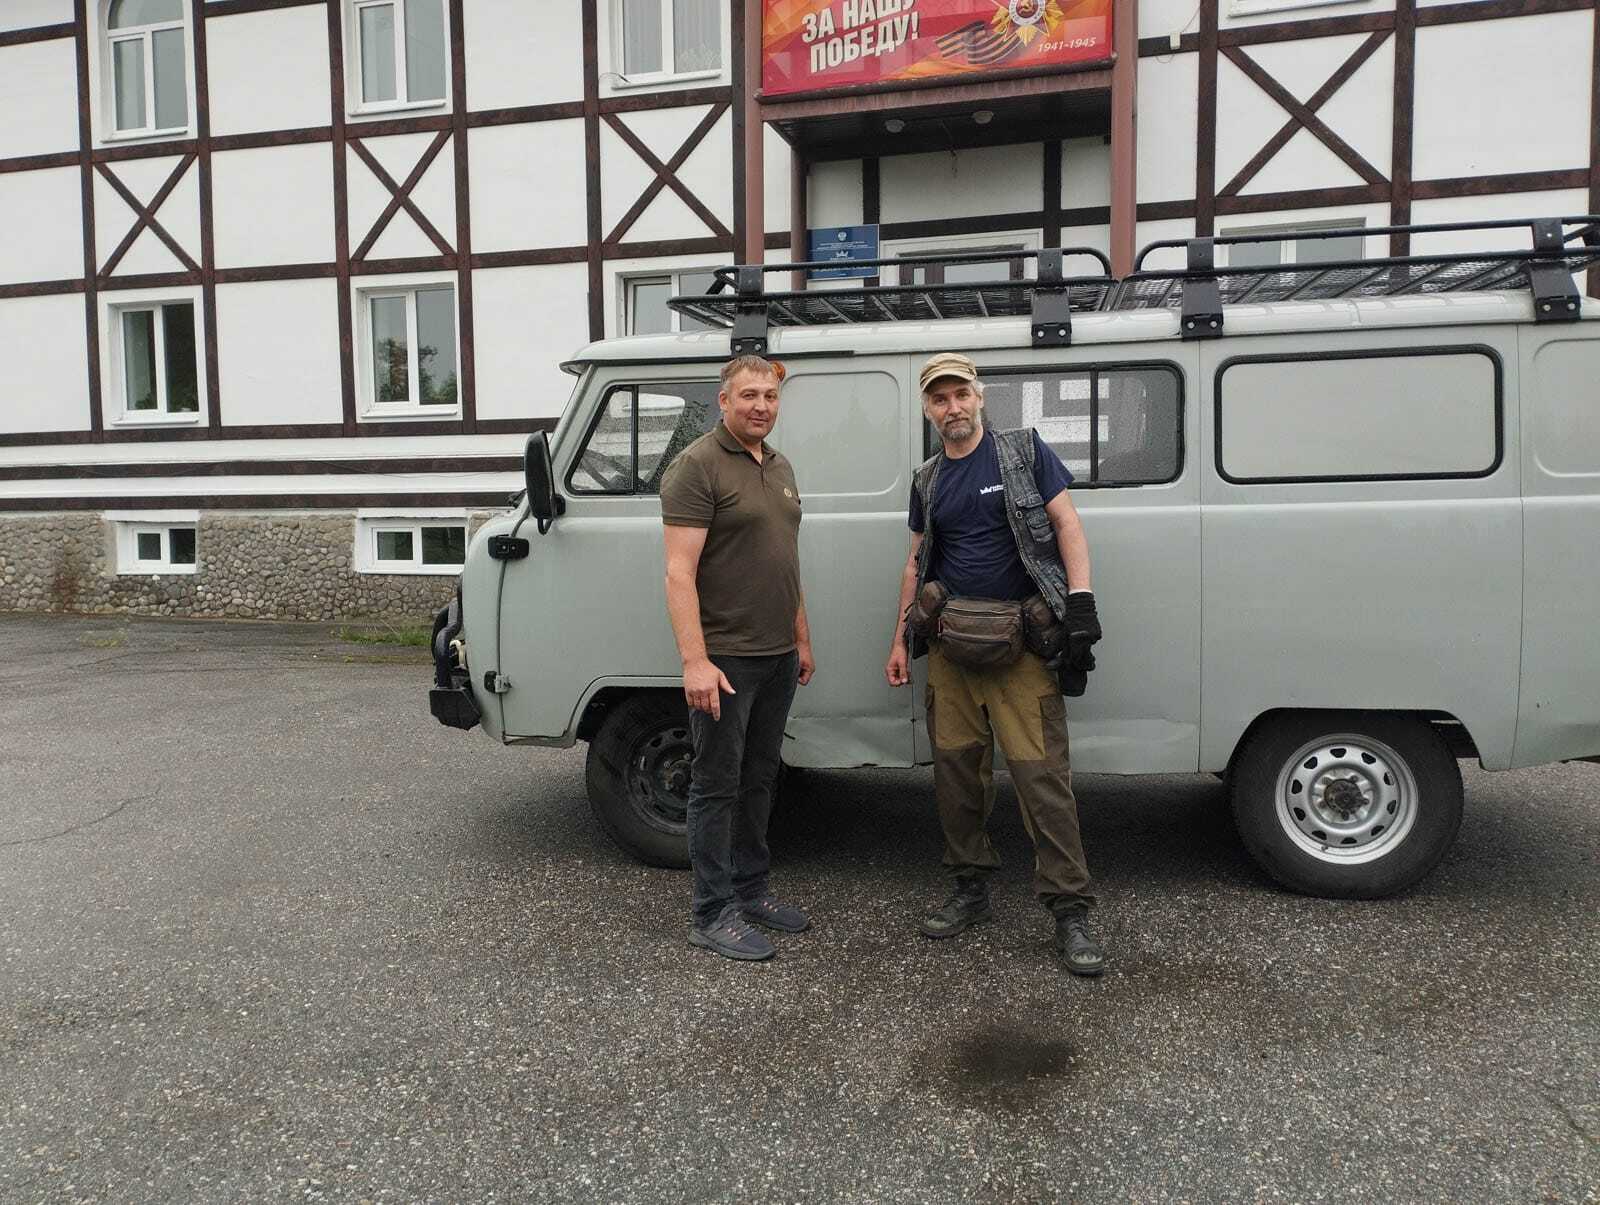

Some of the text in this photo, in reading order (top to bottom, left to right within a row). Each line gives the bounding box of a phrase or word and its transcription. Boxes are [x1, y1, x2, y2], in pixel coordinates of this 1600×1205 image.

[802, 8, 835, 43] ЗА
[810, 11, 919, 73] ПОБЕДУ!
[1038, 37, 1097, 53] 1941-1945
